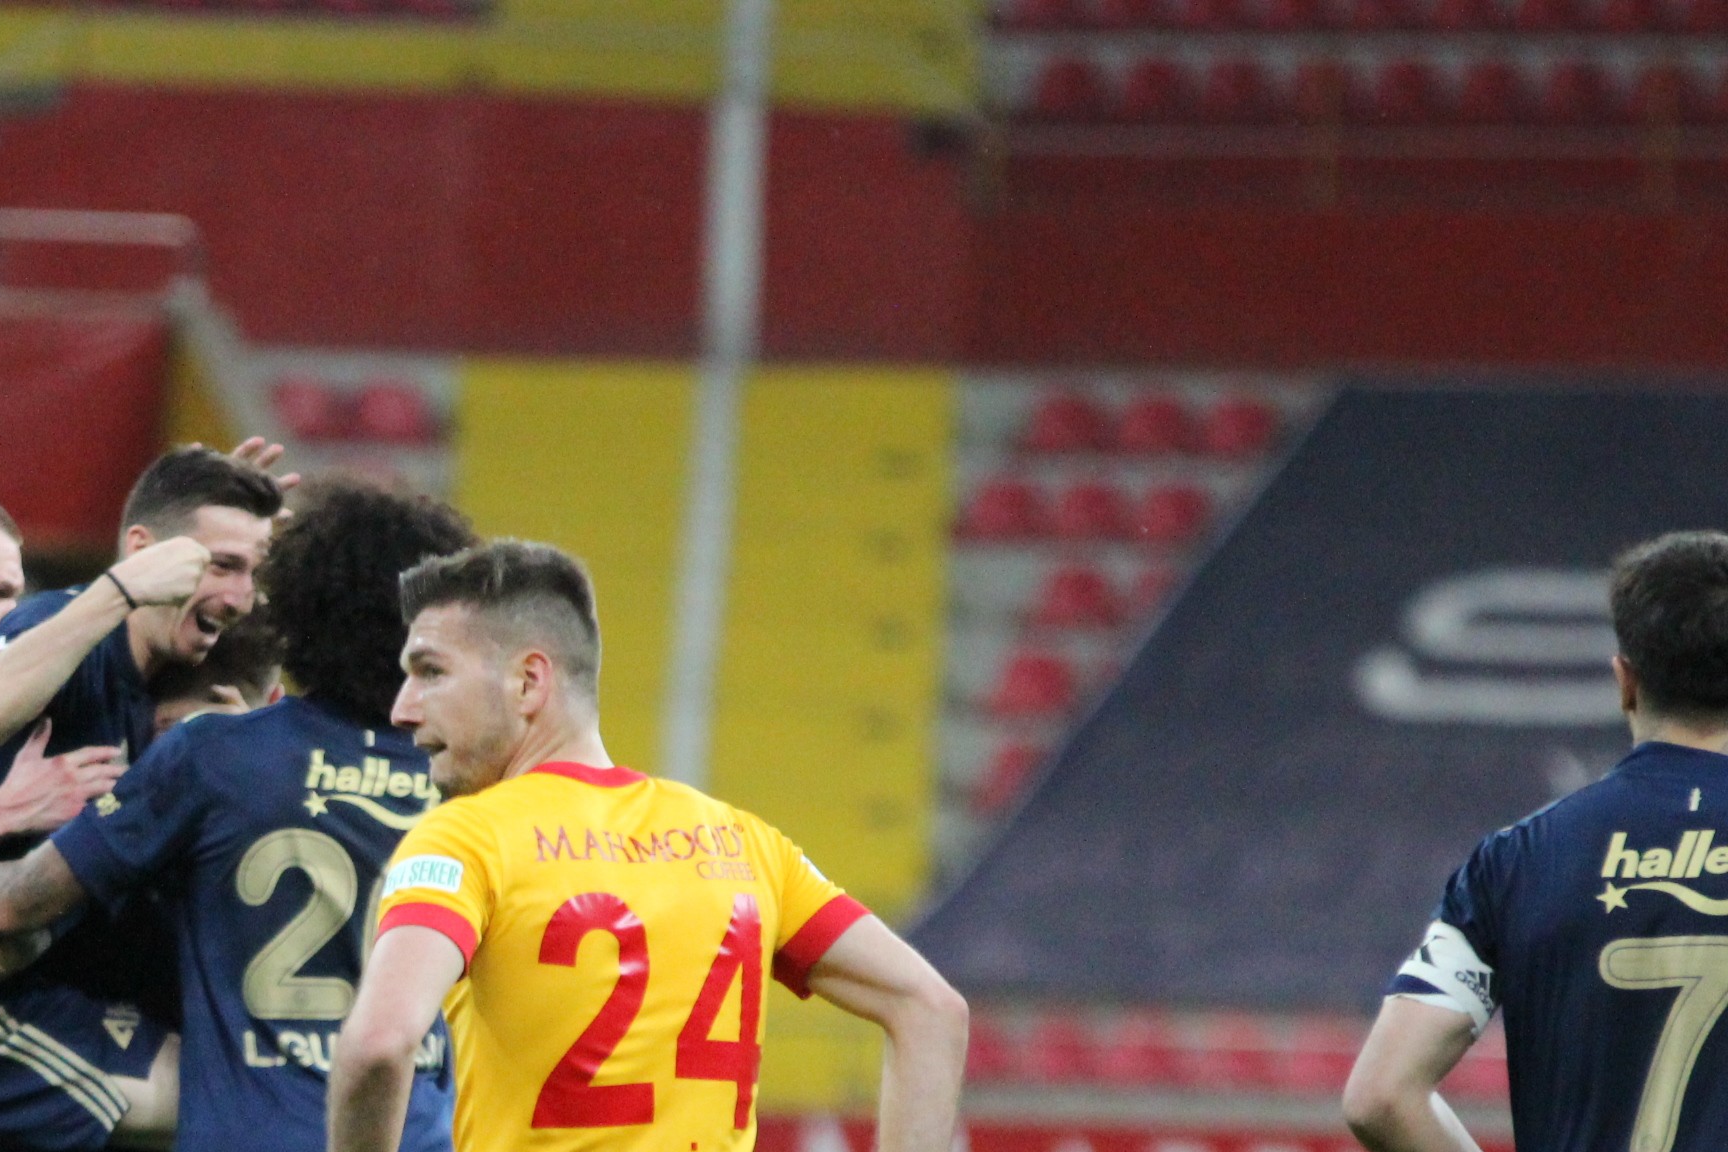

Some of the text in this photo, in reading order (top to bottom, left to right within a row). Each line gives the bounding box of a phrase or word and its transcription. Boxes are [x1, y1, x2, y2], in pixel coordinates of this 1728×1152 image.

[305, 748, 442, 811] halley
[236, 828, 385, 1020] 2
[531, 892, 763, 1130] 24
